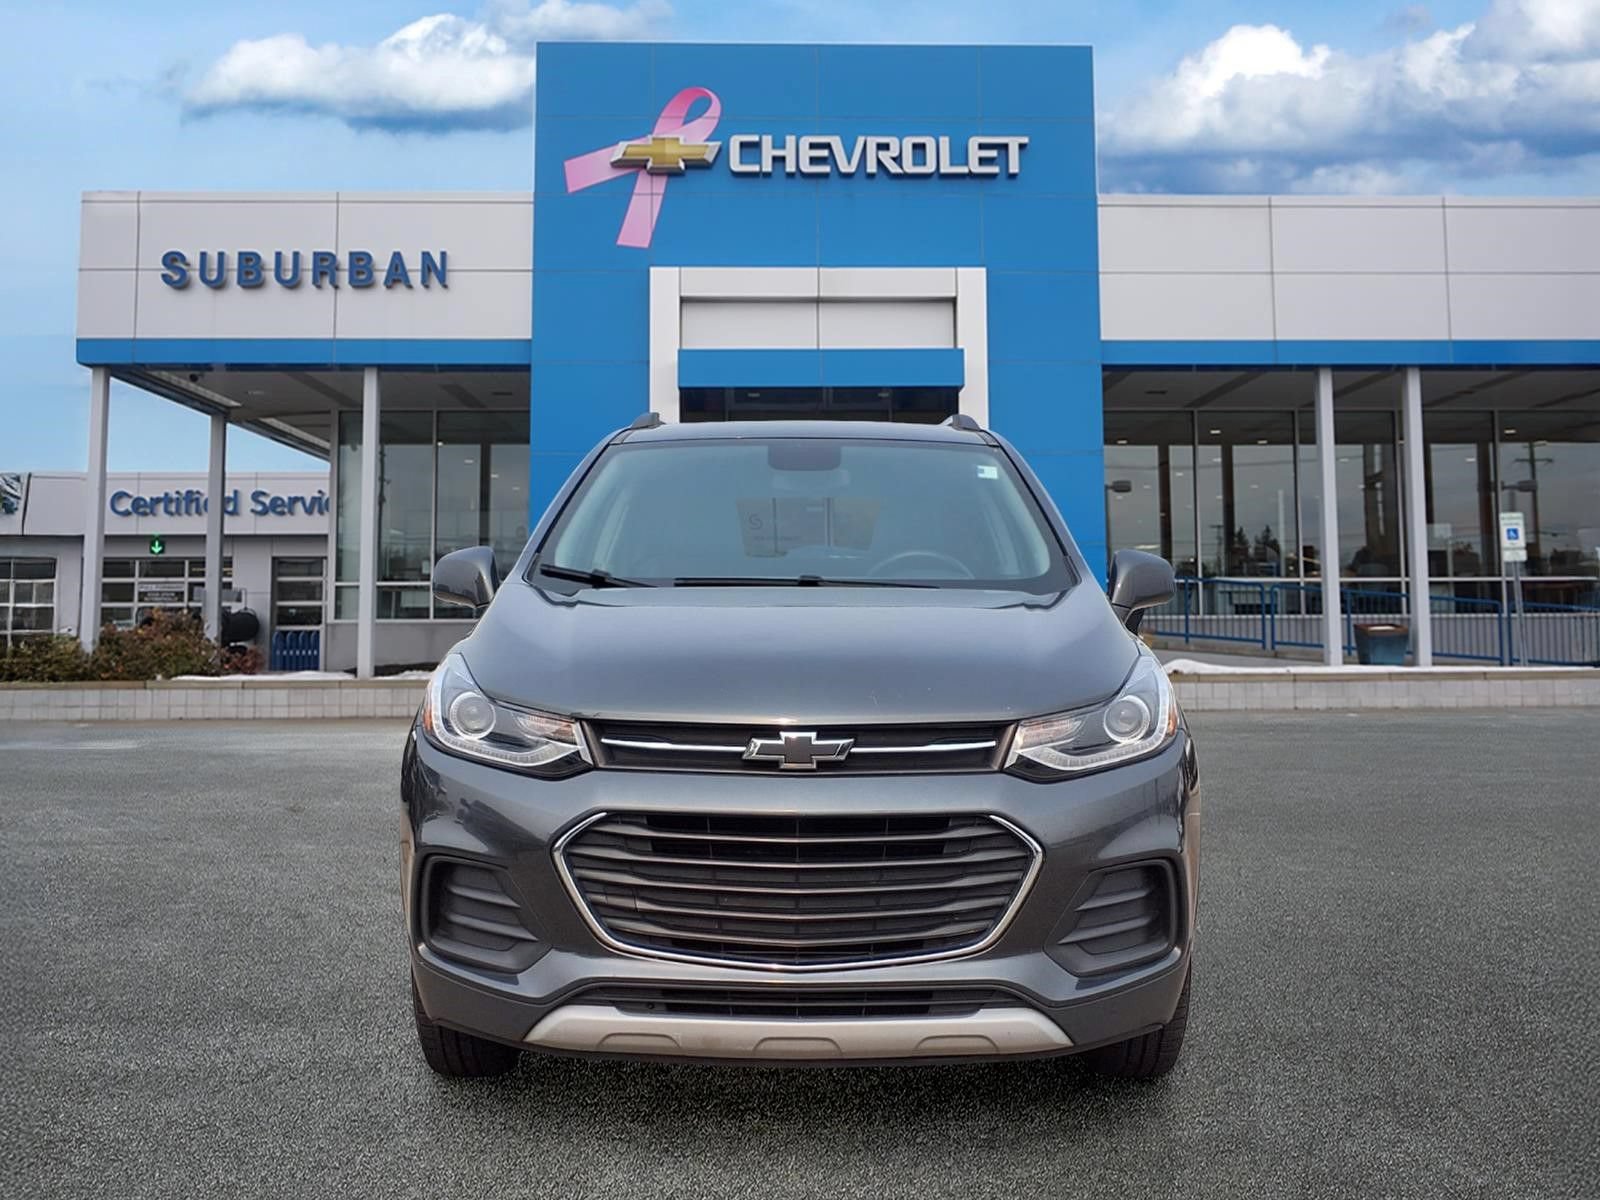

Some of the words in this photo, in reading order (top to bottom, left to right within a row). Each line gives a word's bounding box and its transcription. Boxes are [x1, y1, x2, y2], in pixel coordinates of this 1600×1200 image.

[729, 135, 1029, 175] CHEVROLET
[161, 250, 449, 289] SUBURBAN
[109, 490, 240, 517] Certifid
